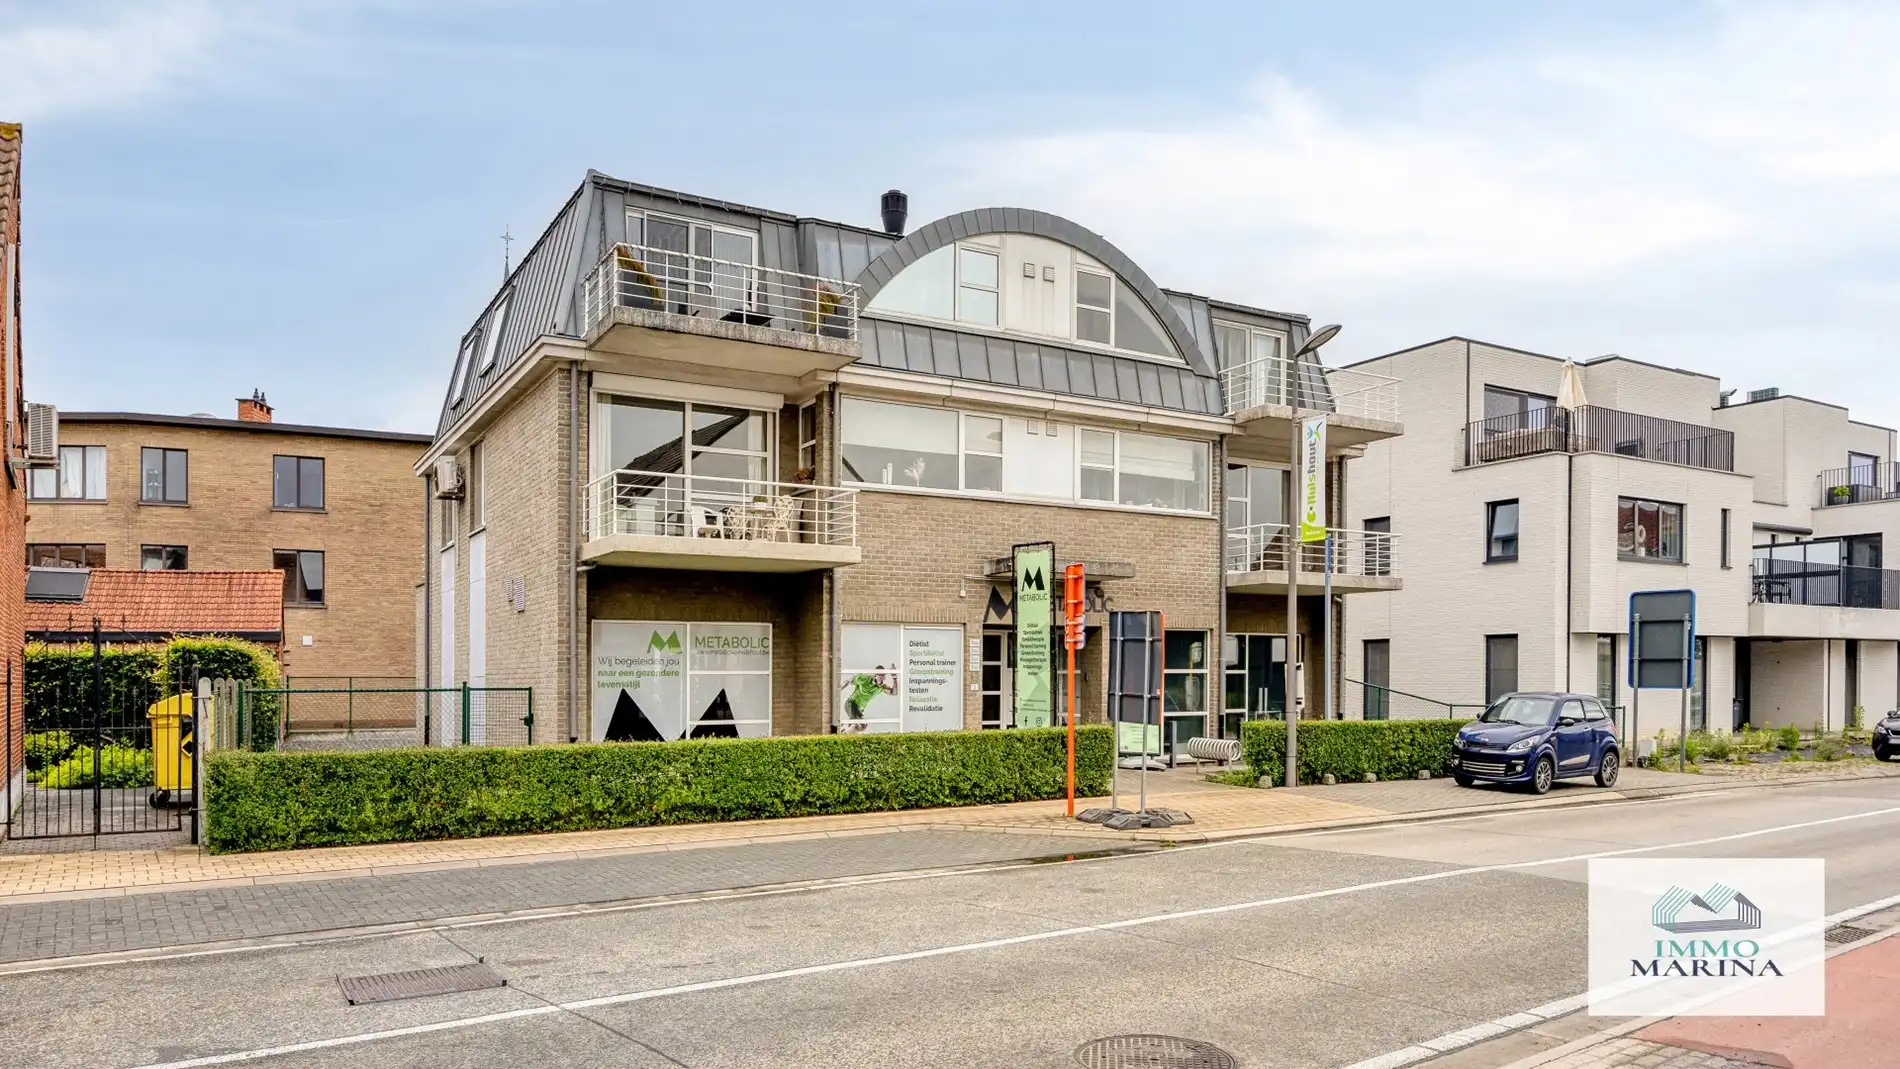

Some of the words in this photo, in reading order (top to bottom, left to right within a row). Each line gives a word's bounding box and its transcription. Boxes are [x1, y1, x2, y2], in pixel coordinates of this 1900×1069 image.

[1019, 592, 1048, 602] METABOLIC
[695, 636, 770, 649] METABOLIC
[598, 656, 613, 667] Wij
[665, 656, 680, 668] jou
[598, 669, 617, 677] naar
[909, 668, 954, 676] Groepstraining
[597, 680, 641, 690] levensstijl
[909, 677, 948, 685] Inspannings-
